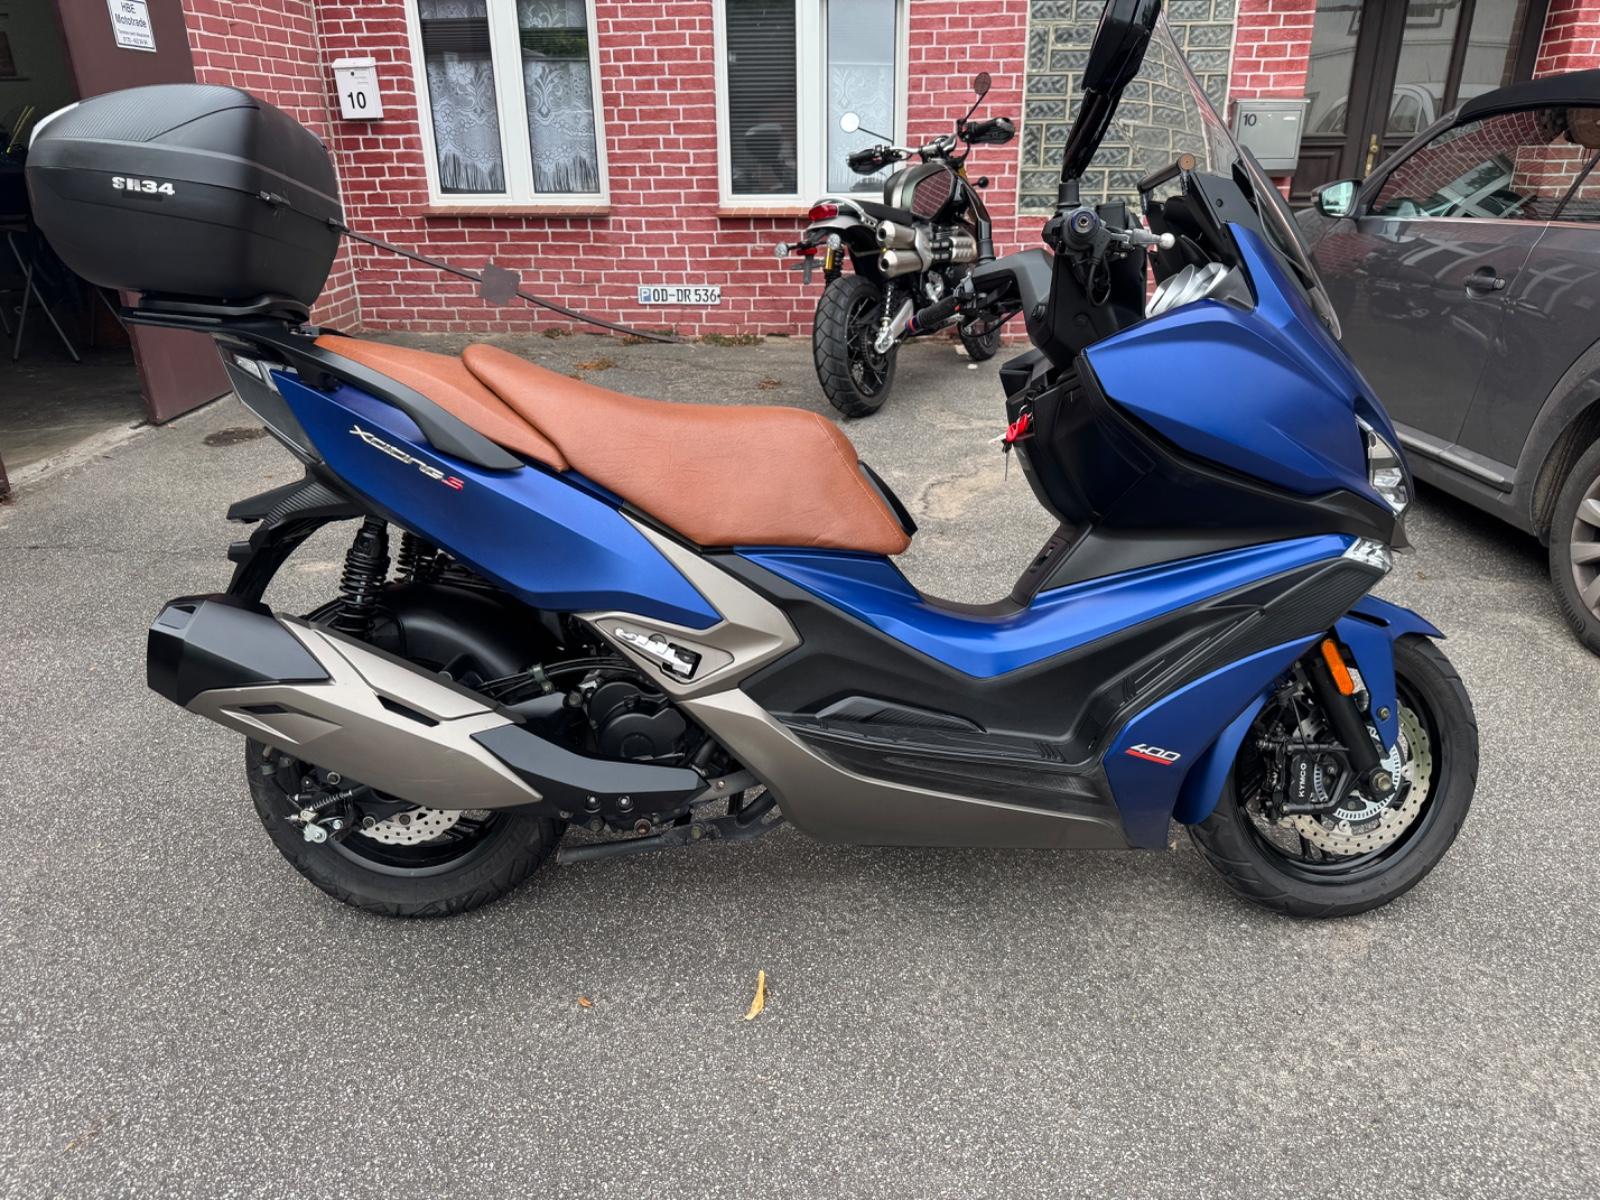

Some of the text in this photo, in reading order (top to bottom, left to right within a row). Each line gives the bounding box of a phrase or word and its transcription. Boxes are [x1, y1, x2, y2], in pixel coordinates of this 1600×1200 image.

[347, 91, 366, 109] 10
[1243, 113, 1257, 127] 10
[694, 288, 717, 303] 536
[1130, 743, 1181, 762] 400
[1298, 762, 1307, 798] KYMCO
